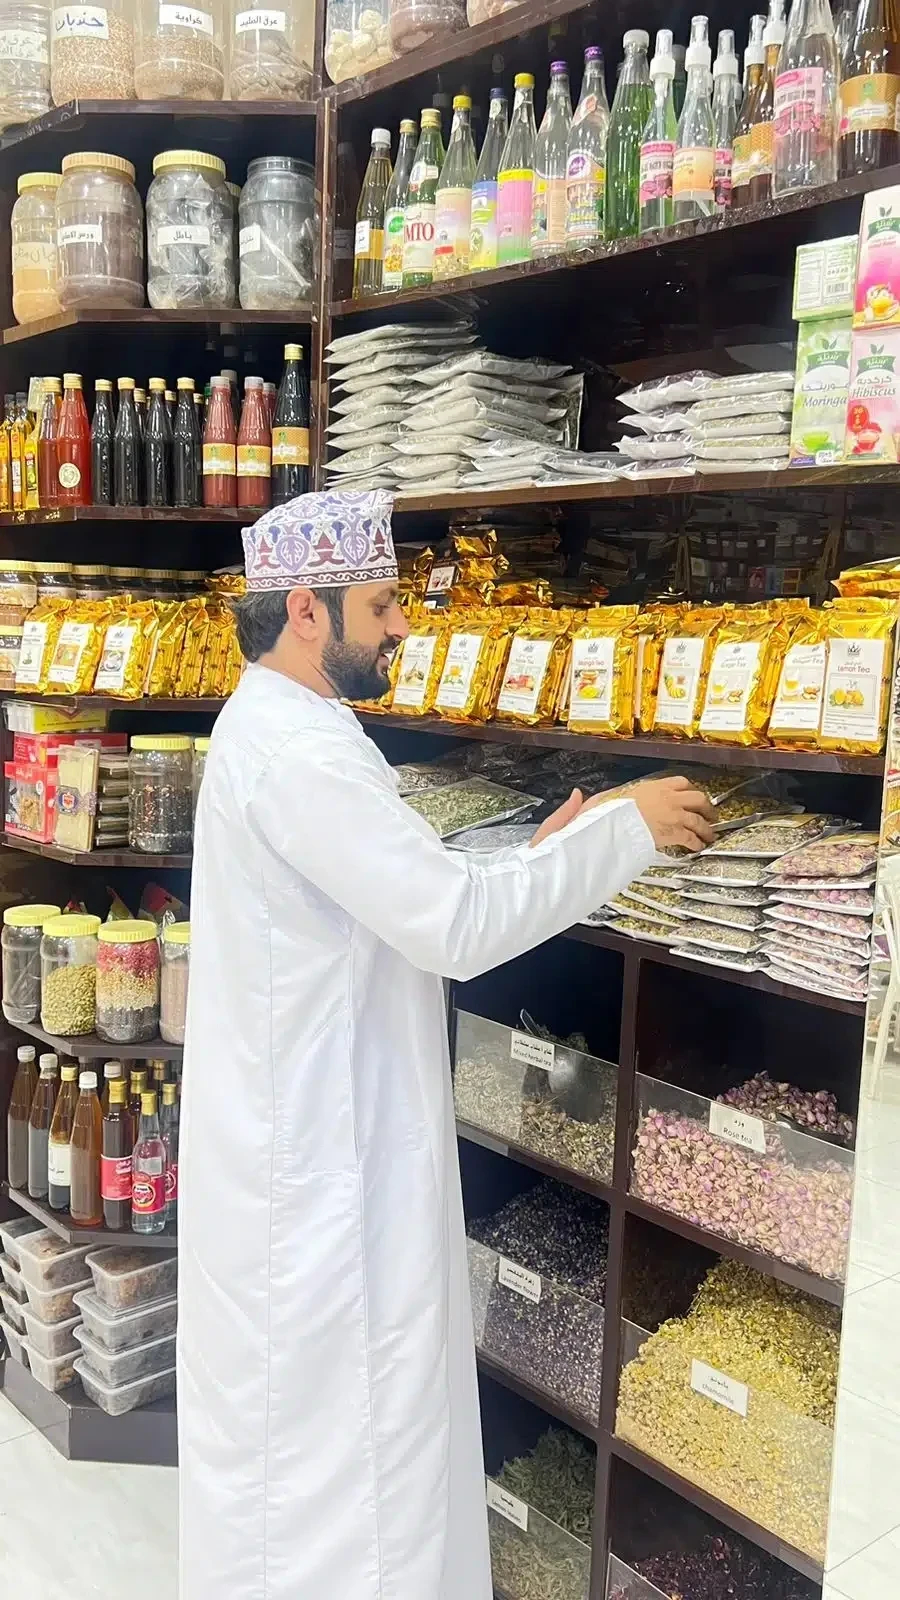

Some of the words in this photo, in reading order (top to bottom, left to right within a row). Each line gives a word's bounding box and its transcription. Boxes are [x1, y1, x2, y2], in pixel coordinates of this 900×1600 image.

[852, 386, 896, 398] Hibiscus
[803, 395, 848, 408] Moringa
[858, 665, 871, 673] Tea
[723, 1127, 740, 1139] Rose
[741, 1134, 753, 1144] tea
